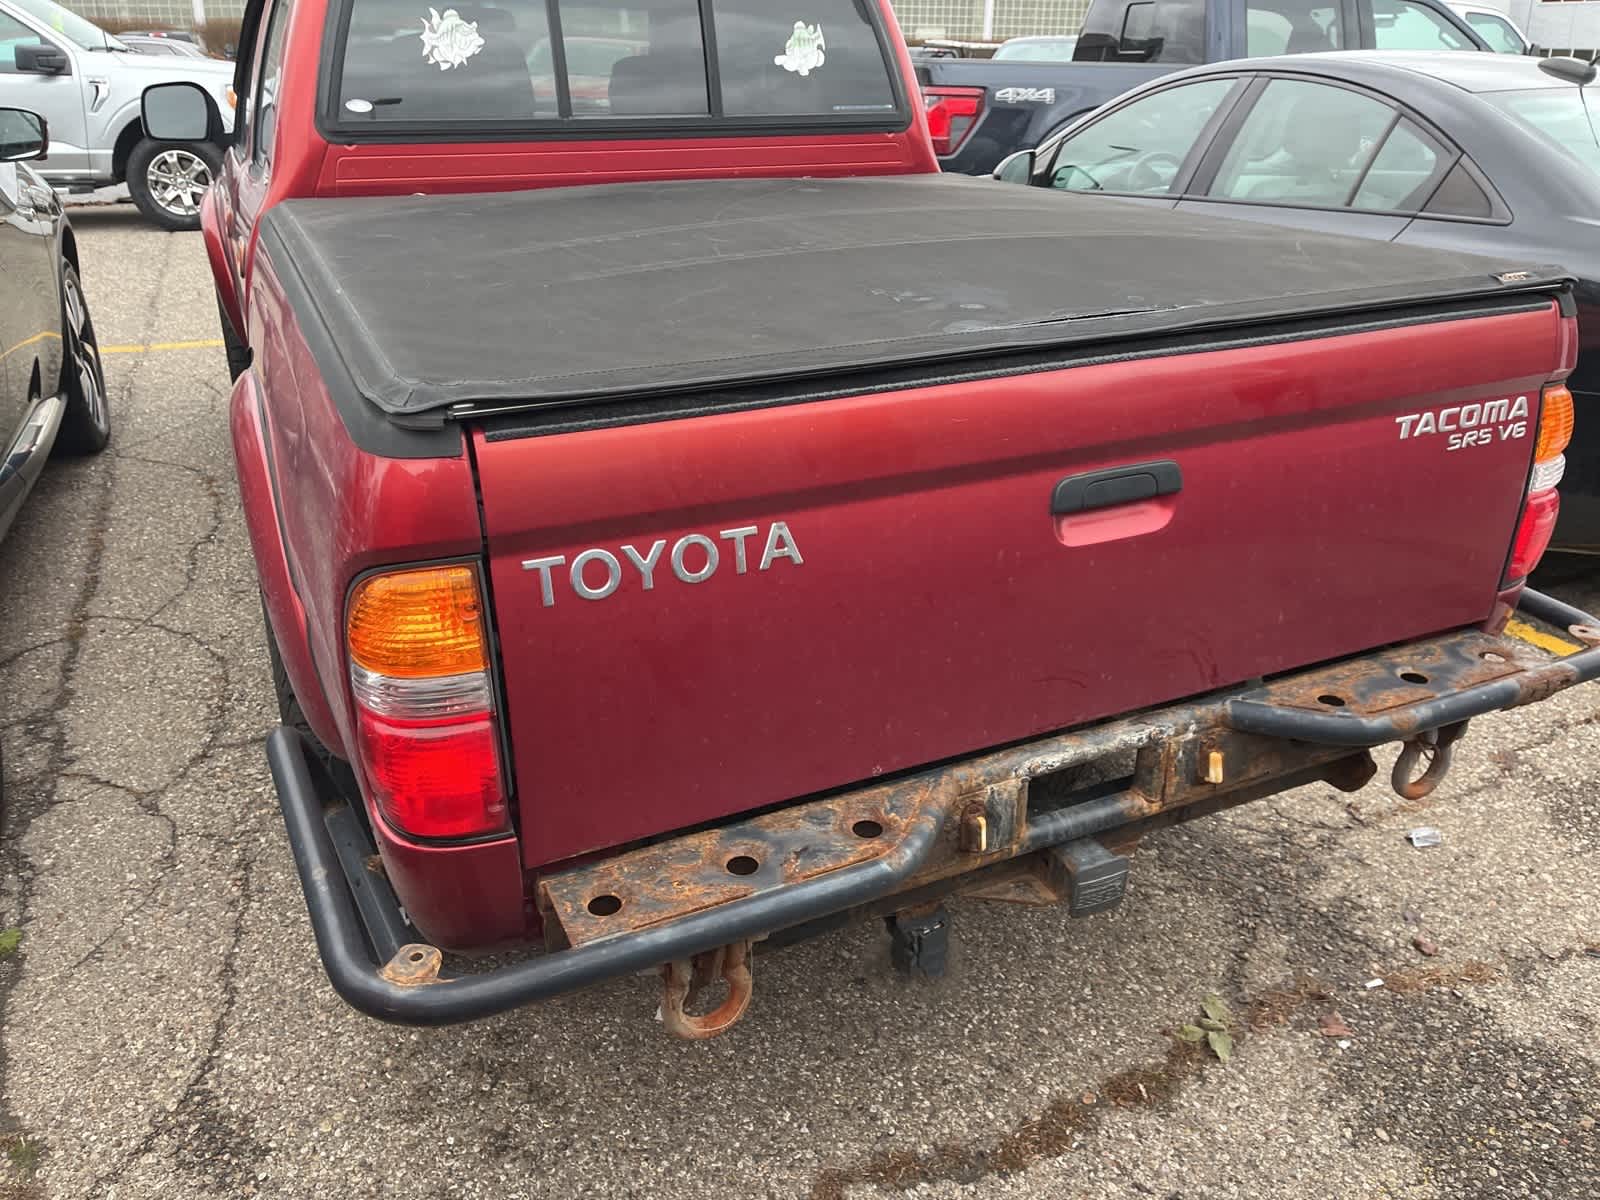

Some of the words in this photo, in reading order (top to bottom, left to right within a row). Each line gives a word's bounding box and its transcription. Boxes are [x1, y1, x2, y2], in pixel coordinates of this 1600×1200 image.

[1395, 396, 1528, 440] TACOMA
[1498, 421, 1527, 441] V6
[521, 521, 804, 608] TOYOTA
